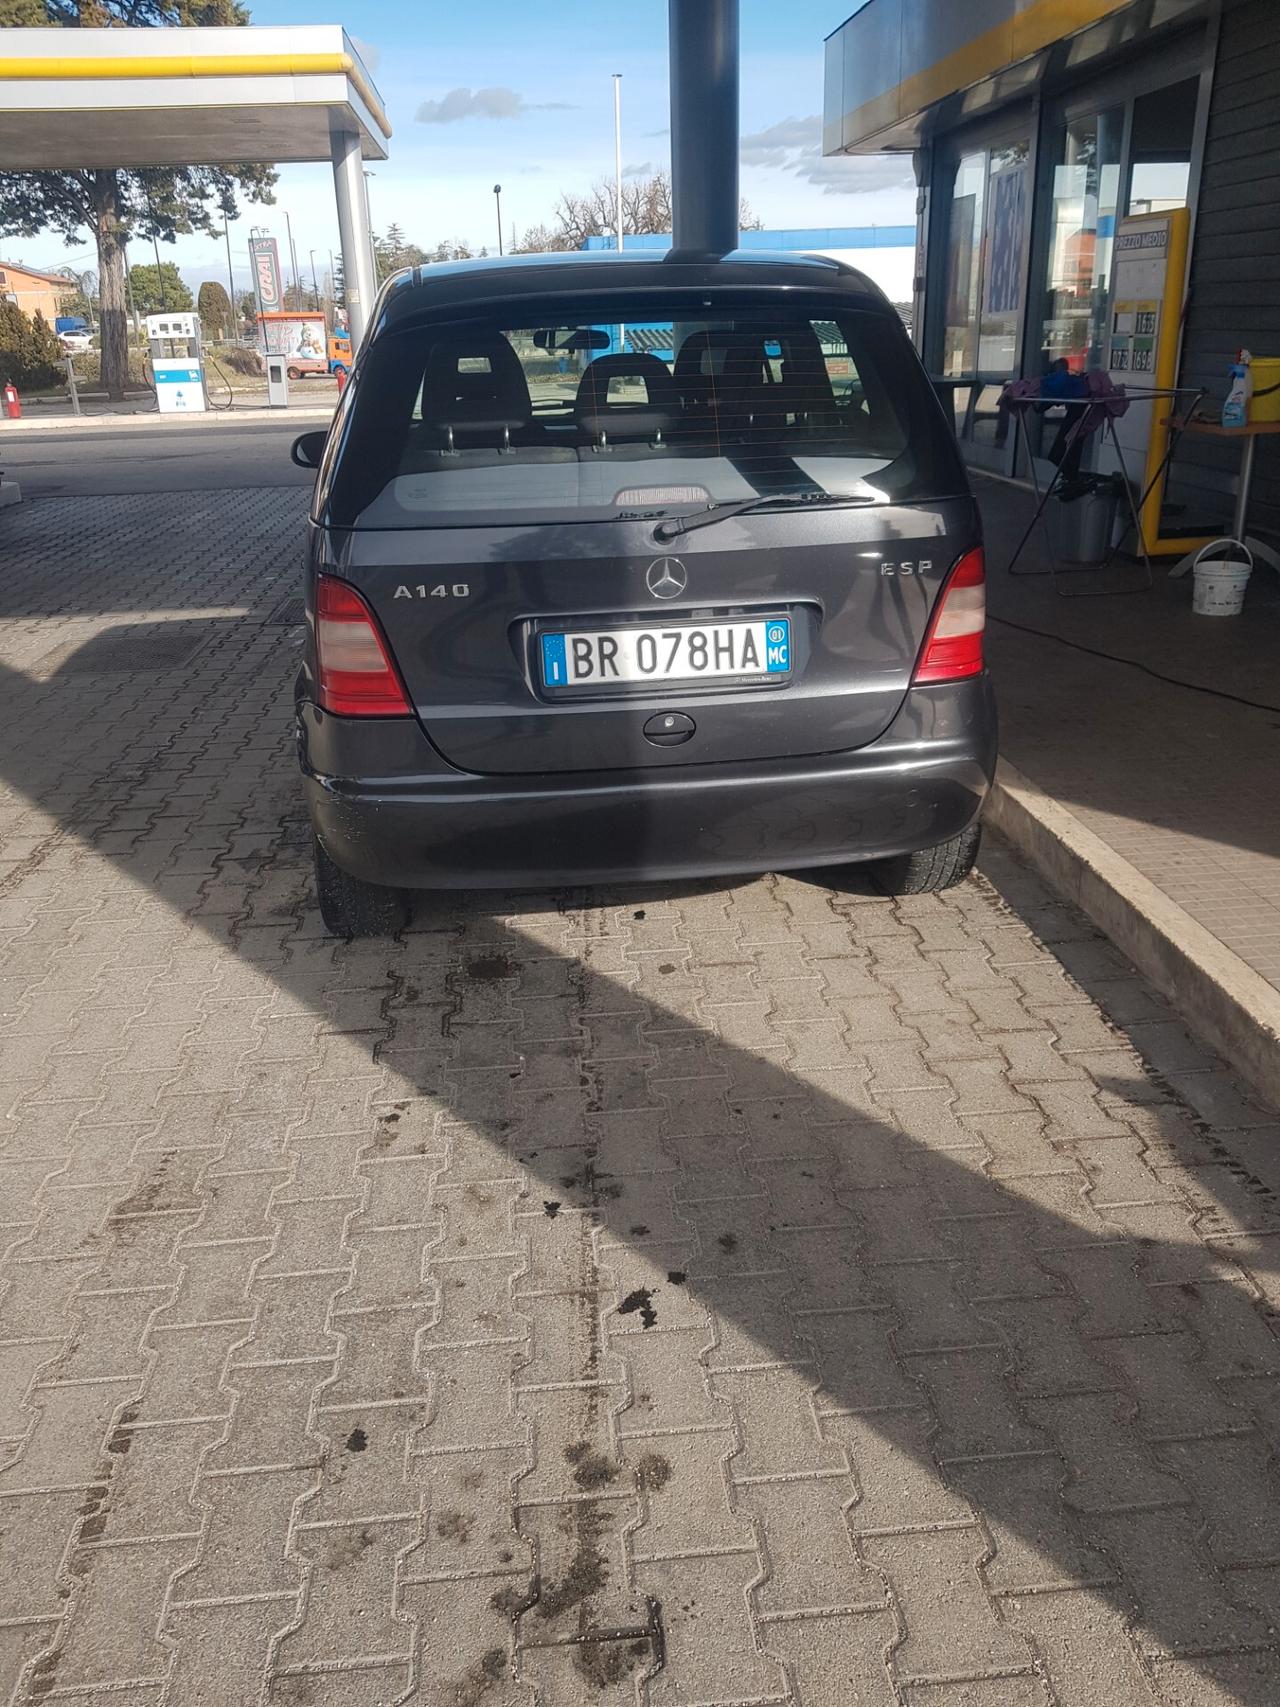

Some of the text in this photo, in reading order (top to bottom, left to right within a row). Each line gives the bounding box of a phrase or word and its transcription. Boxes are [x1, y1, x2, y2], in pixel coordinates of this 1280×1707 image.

[1115, 232, 1167, 249] PREZZO MEDIO
[256, 256, 274, 300] CRAI
[881, 560, 932, 576] ESP
[393, 584, 469, 599] A140
[571, 636, 620, 679] BR
[636, 628, 760, 674] 078HA
[768, 645, 787, 665] MC
